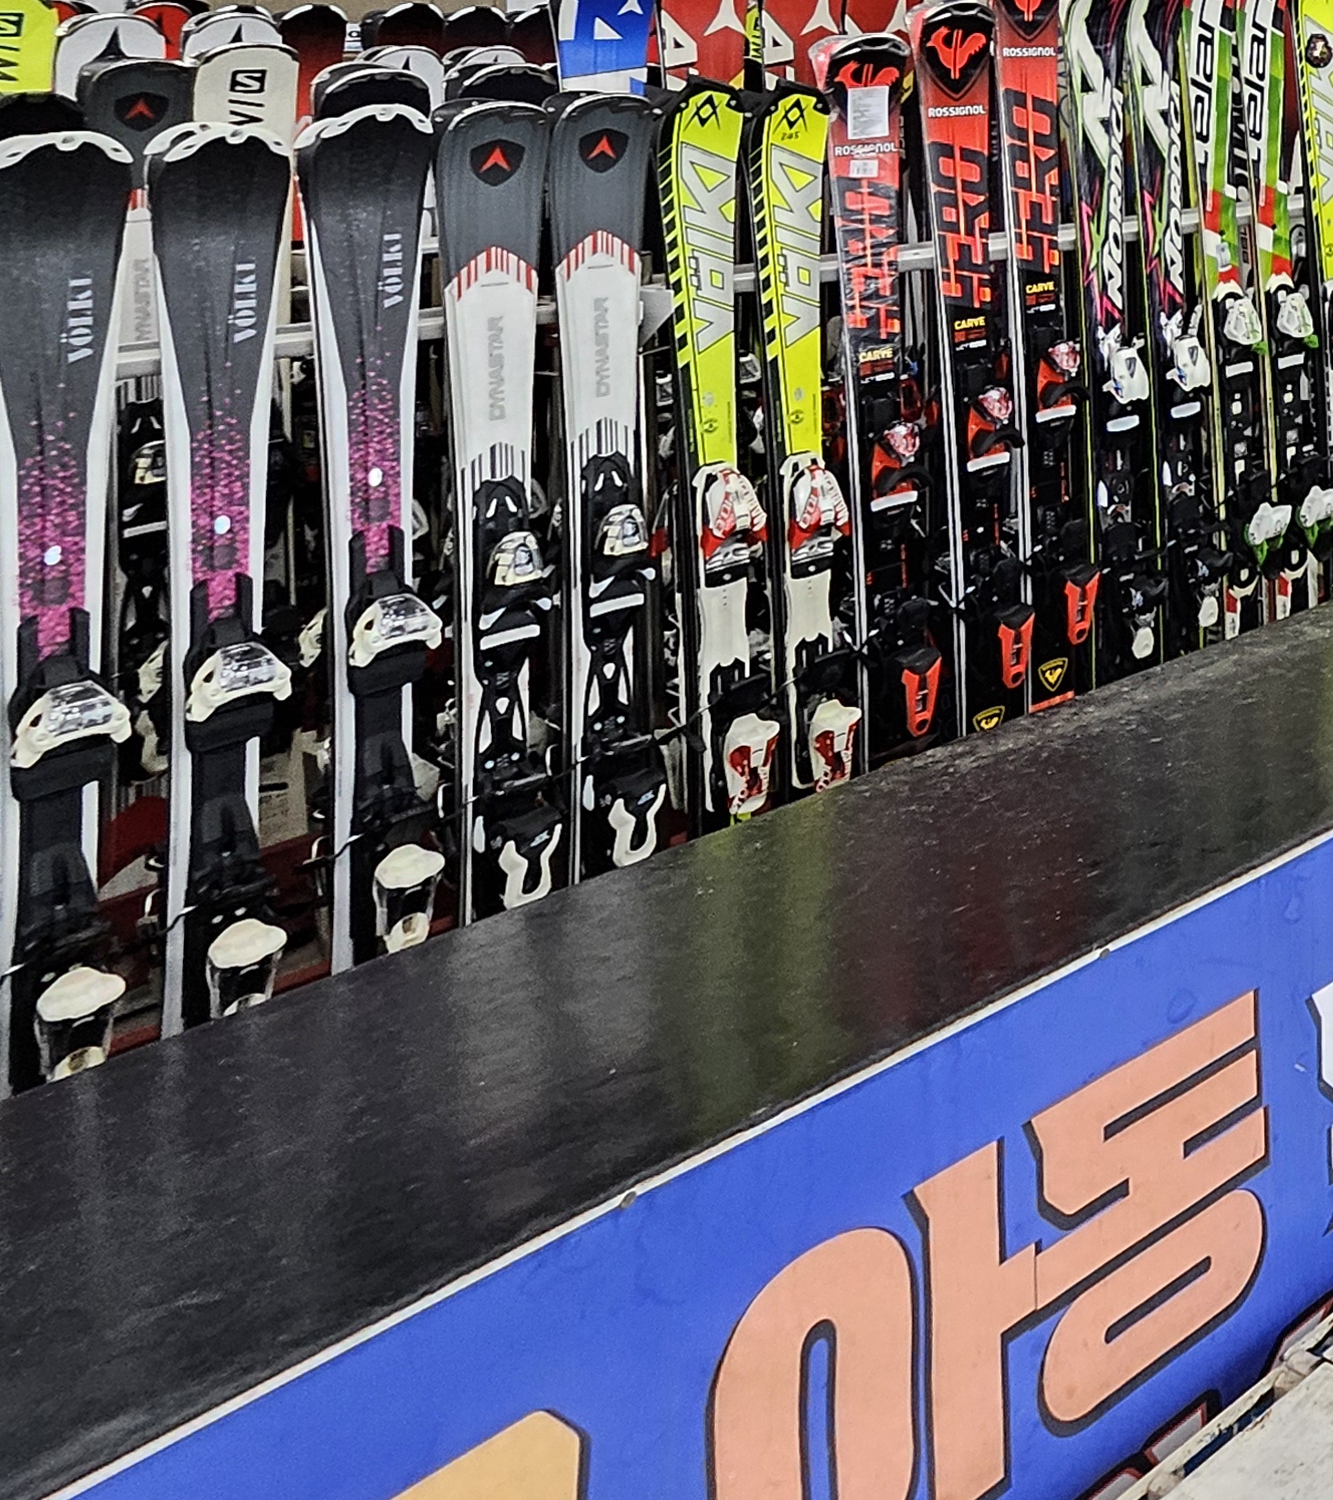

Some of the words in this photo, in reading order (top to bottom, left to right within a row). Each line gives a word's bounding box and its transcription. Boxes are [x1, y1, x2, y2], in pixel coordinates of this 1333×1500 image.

[1003, 46, 1056, 58] ROSSIGNOL
[928, 105, 986, 118] ROSSIGNOL
[1103, 86, 1124, 310] NORDICA
[1164, 80, 1184, 294] NORDICA
[954, 316, 985, 330] CARVE
[1026, 281, 1054, 294] CARVE
[487, 315, 506, 421] DYNASTAR
[593, 296, 611, 398] DYNASTAR
[708, 989, 1268, 1500] 아동
